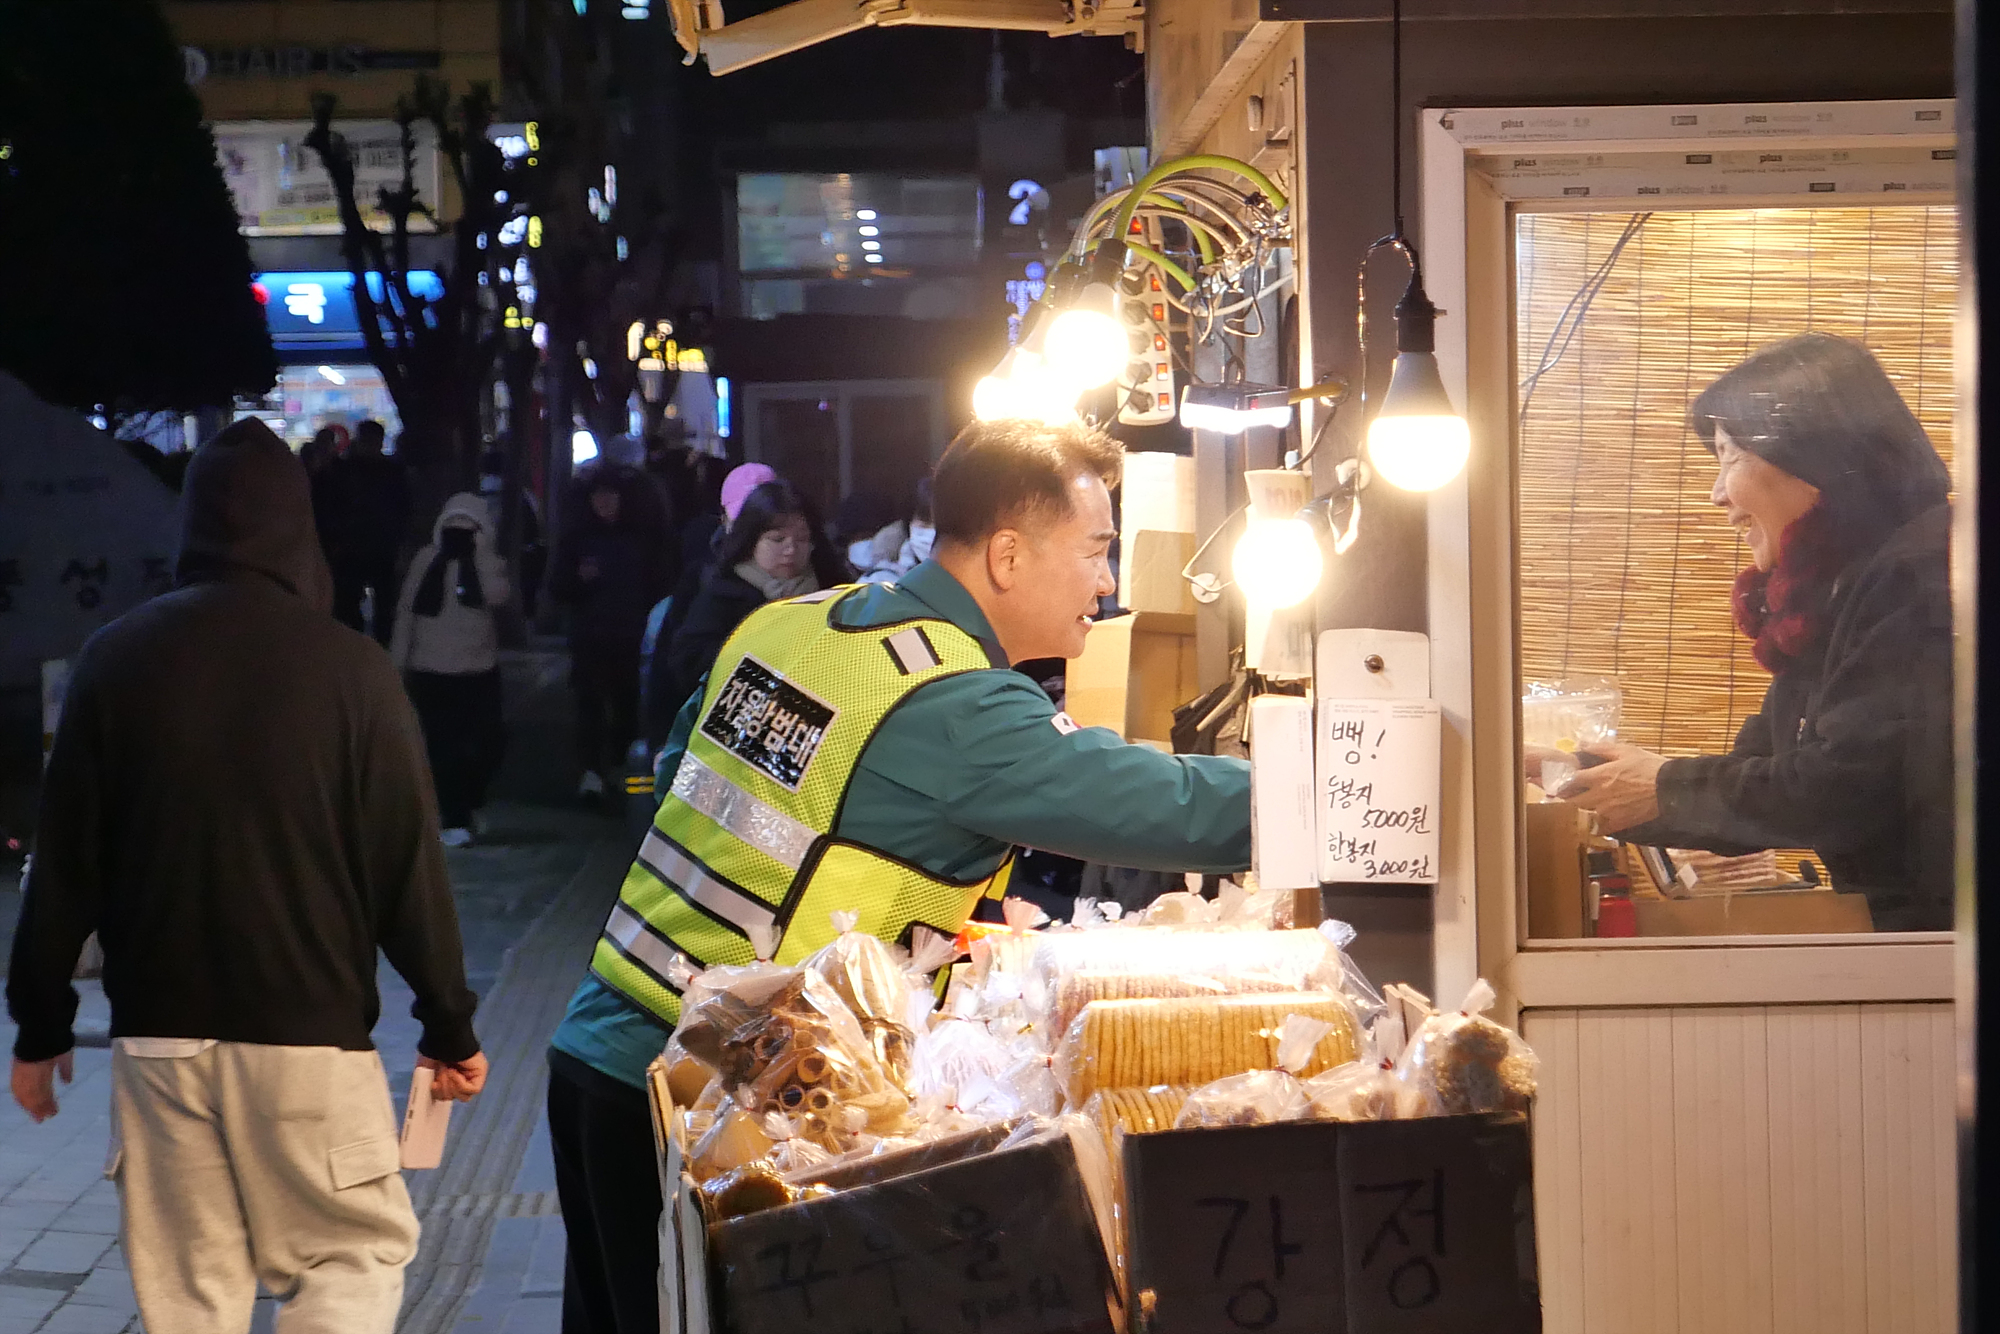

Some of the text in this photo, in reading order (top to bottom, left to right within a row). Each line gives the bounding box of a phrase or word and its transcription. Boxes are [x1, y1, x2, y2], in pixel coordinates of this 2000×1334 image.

[1501, 119, 1525, 130] plus
[1514, 158, 1537, 169] plus
[1760, 154, 1783, 163] plus
[1637, 186, 1660, 195] plus
[1883, 182, 1906, 192] plus
[719, 678, 822, 768] 자율방범대
[1328, 830, 1376, 863] 한봉지
[1194, 1167, 1447, 1331] 강정
